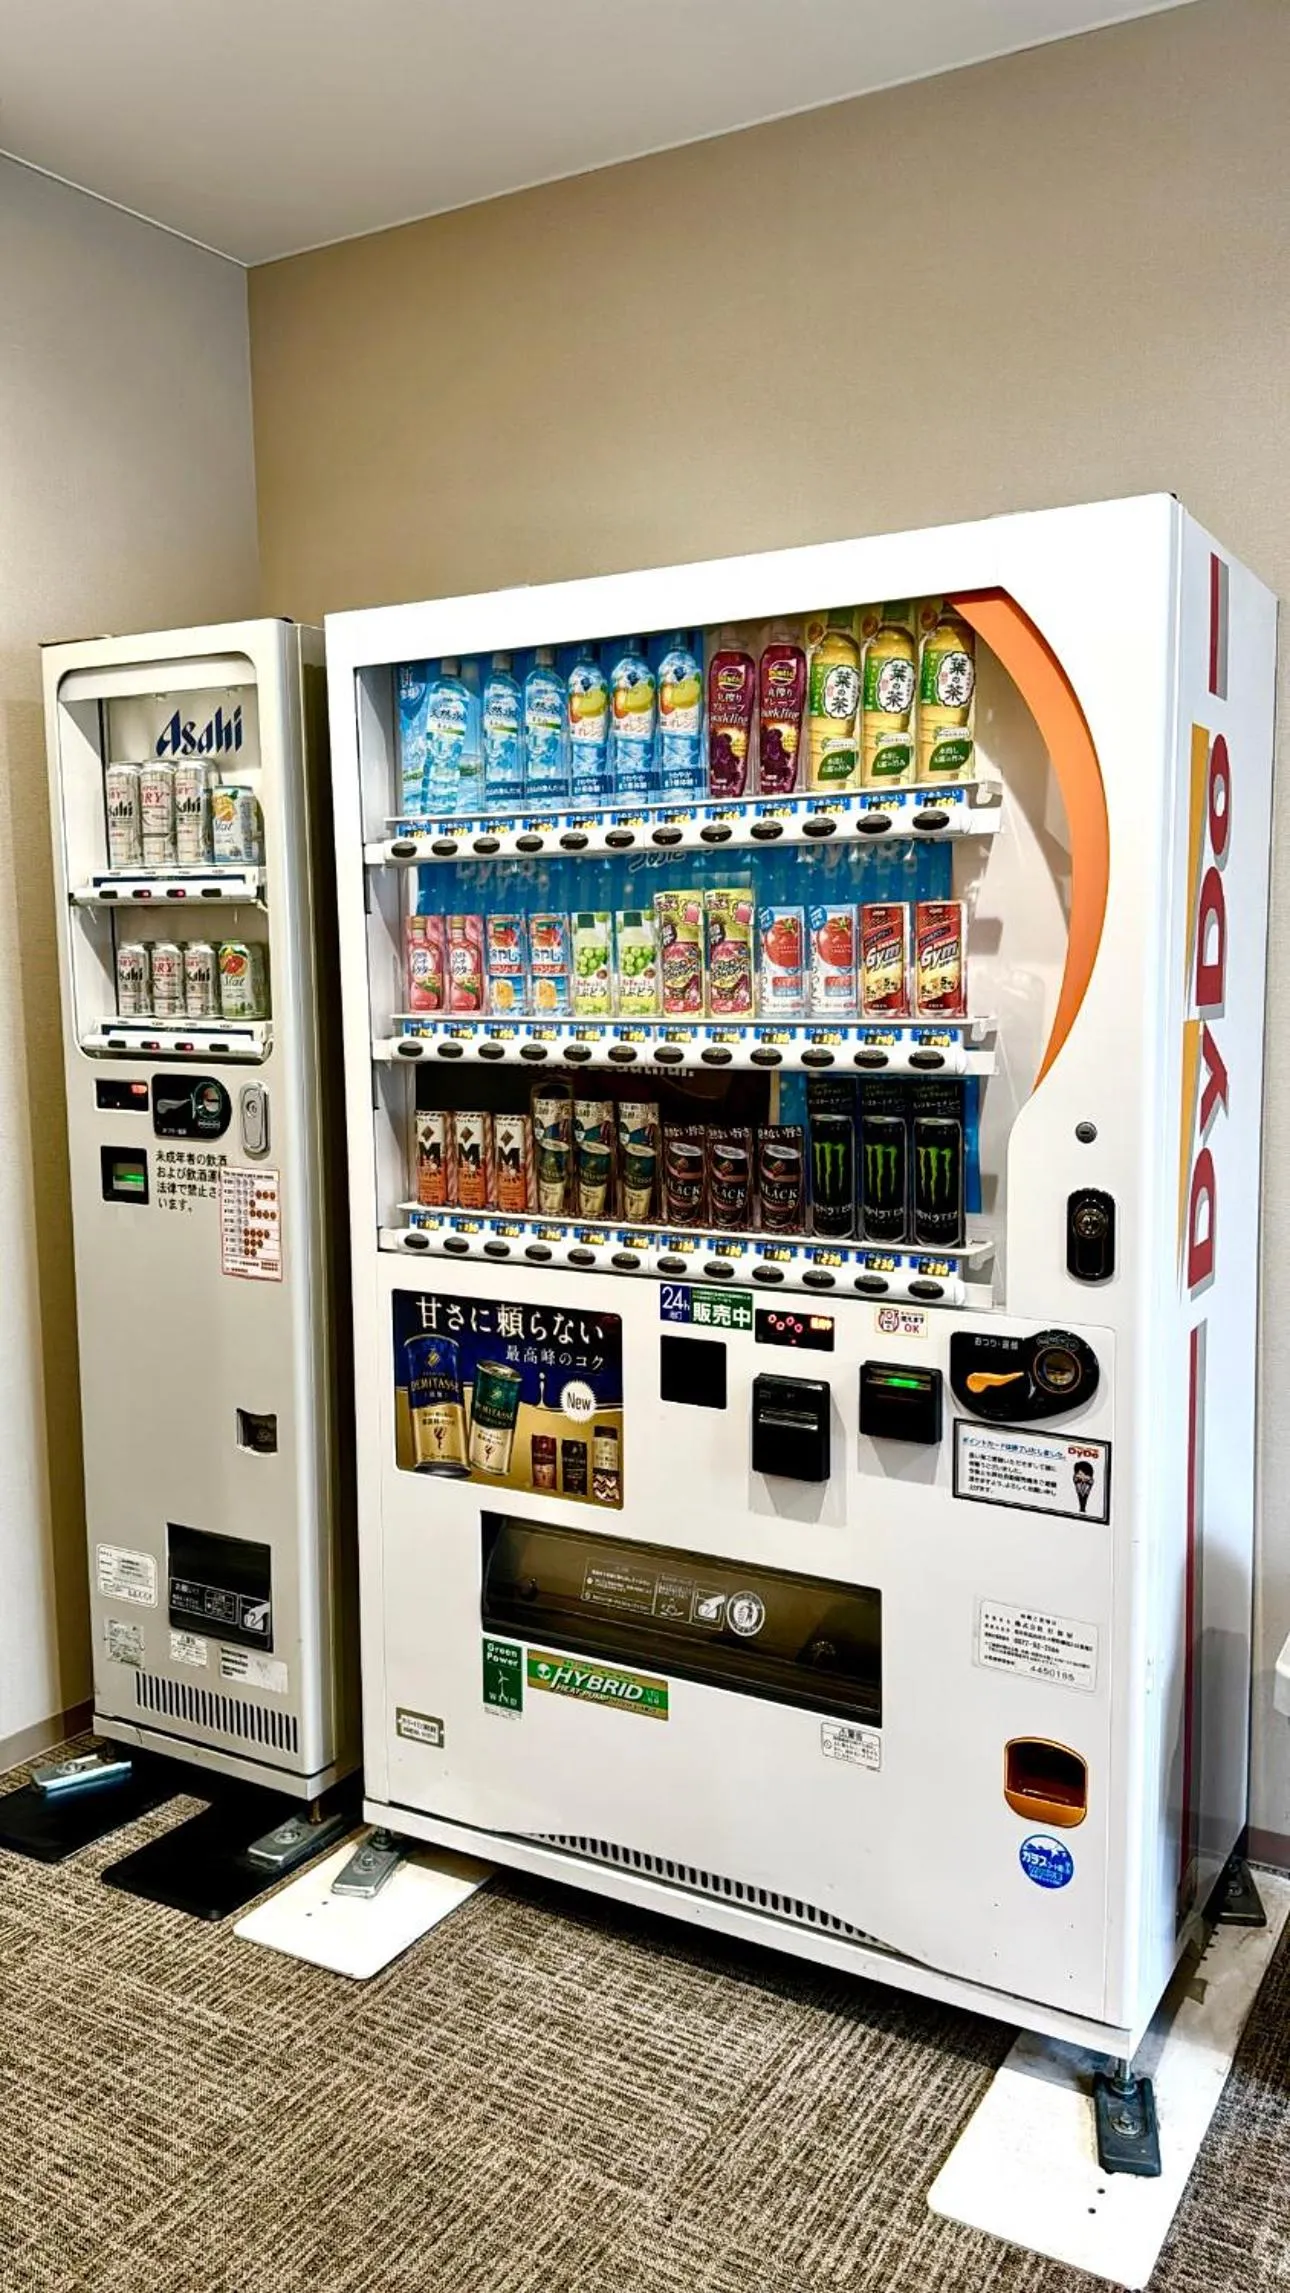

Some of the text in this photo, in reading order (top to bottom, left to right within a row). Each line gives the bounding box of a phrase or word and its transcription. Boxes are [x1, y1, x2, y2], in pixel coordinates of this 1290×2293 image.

[156, 704, 243, 757] Asahi
[921, 940, 958, 969] Gym
[1186, 731, 1230, 1292] DyDo
[661, 1285, 691, 1311] 24h
[415, 1296, 604, 1345] 甘さに頼らない
[692, 1301, 751, 1328] 販売中
[904, 1323, 920, 1334] OK
[505, 1345, 604, 1371] 最高峰のコク
[566, 1391, 592, 1412] New
[1067, 1446, 1100, 1459] DyDo
[486, 1642, 518, 1658] Green
[486, 1651, 519, 1667] Power
[549, 1667, 644, 1700] HYBRID
